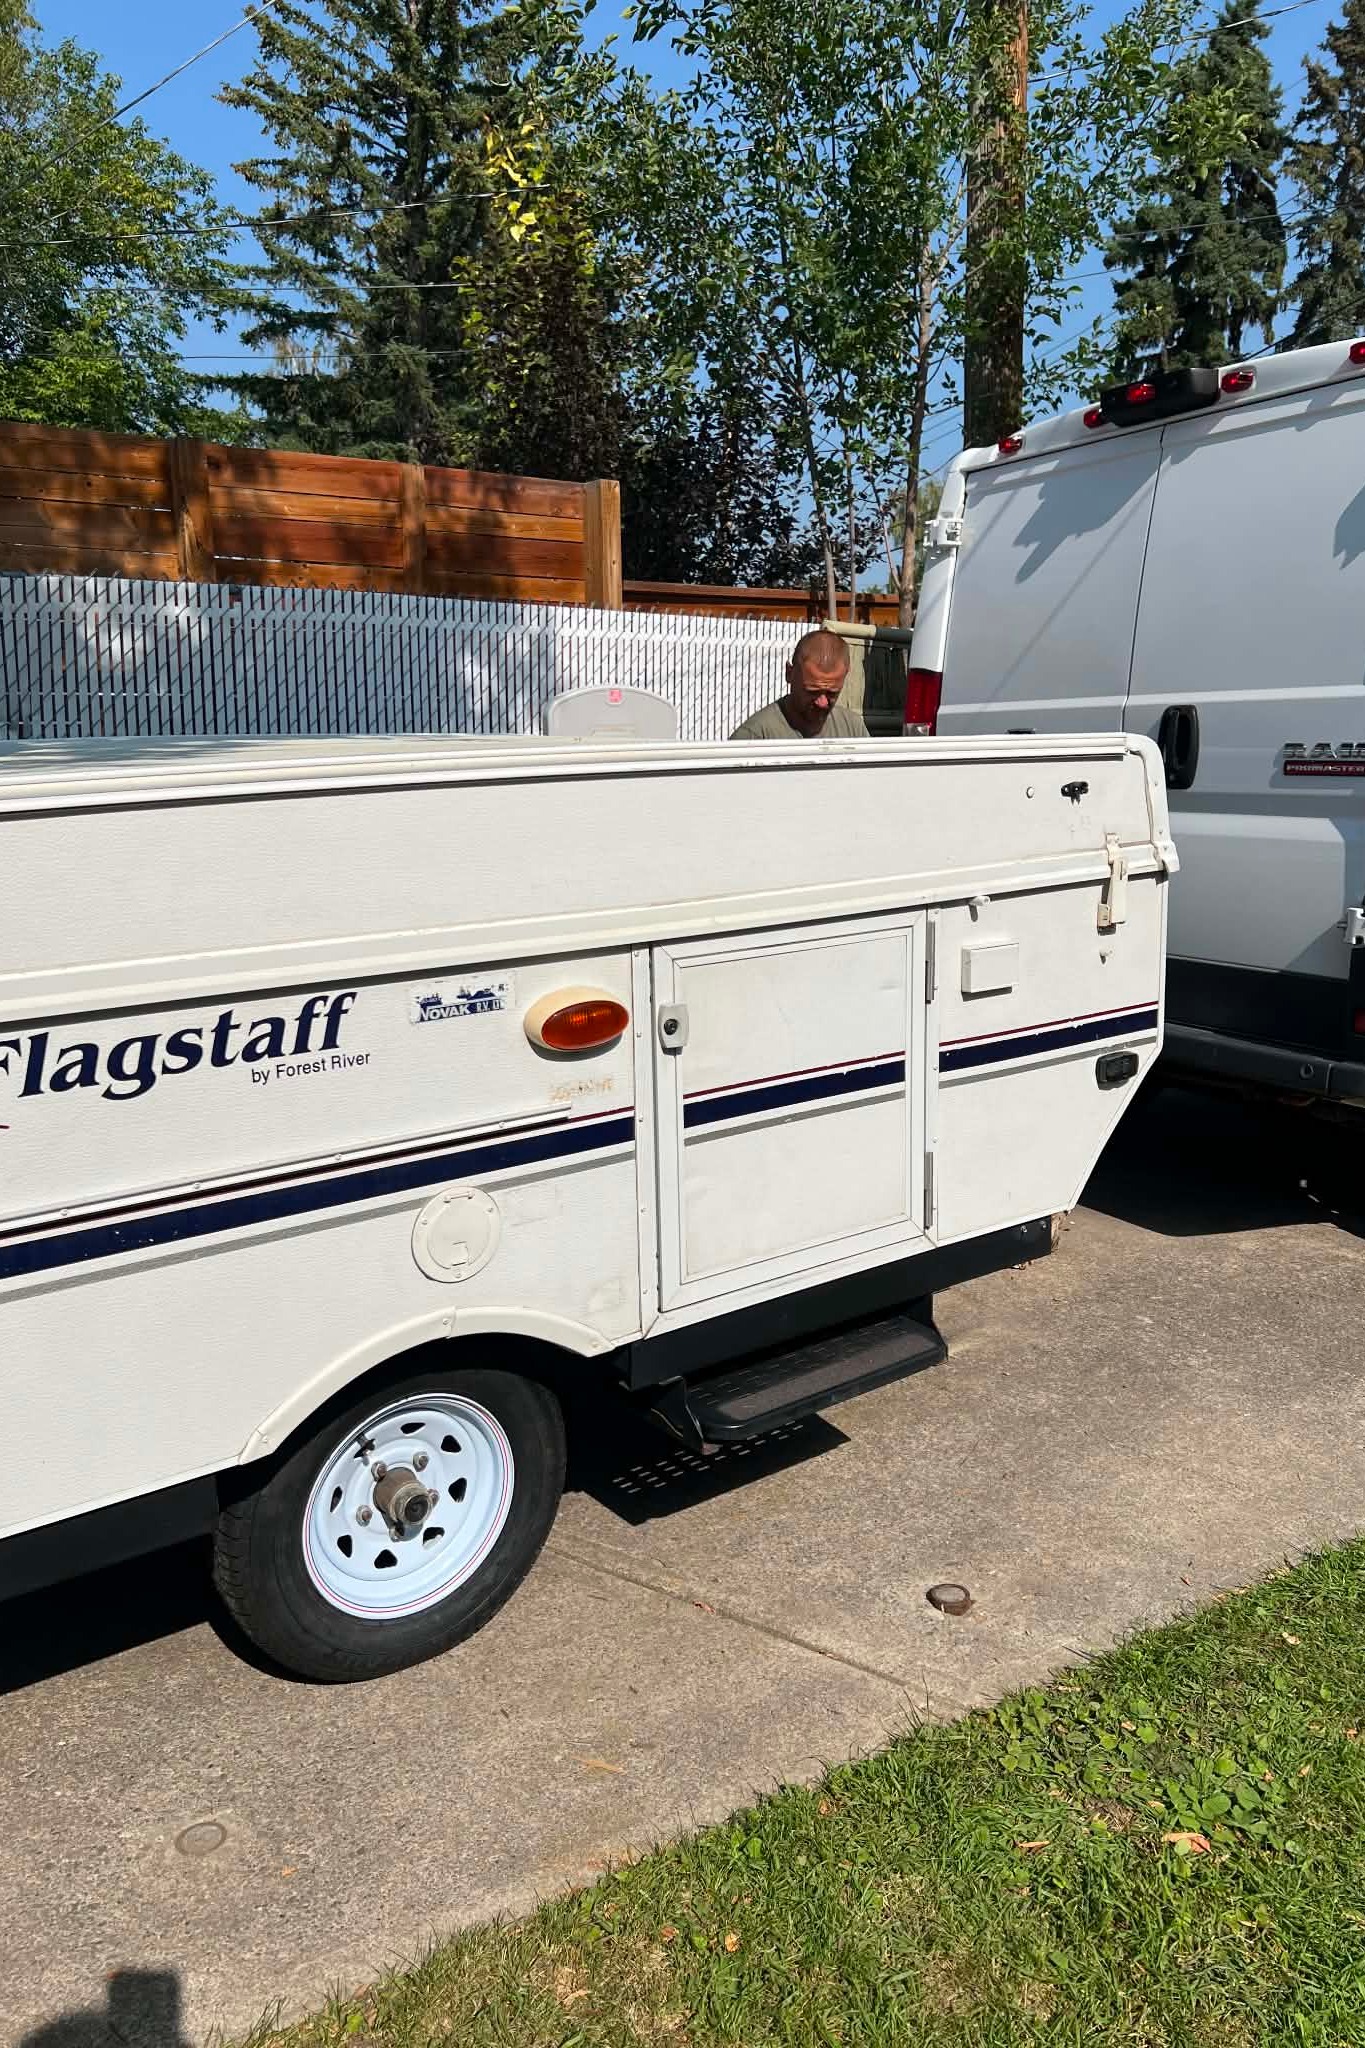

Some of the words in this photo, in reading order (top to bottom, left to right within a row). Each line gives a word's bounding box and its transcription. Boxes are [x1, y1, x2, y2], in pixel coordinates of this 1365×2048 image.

[418, 1003, 471, 1022] NOVAK
[251, 1068, 270, 1086] by
[276, 1058, 327, 1079] Forest
[331, 1053, 371, 1070] River
